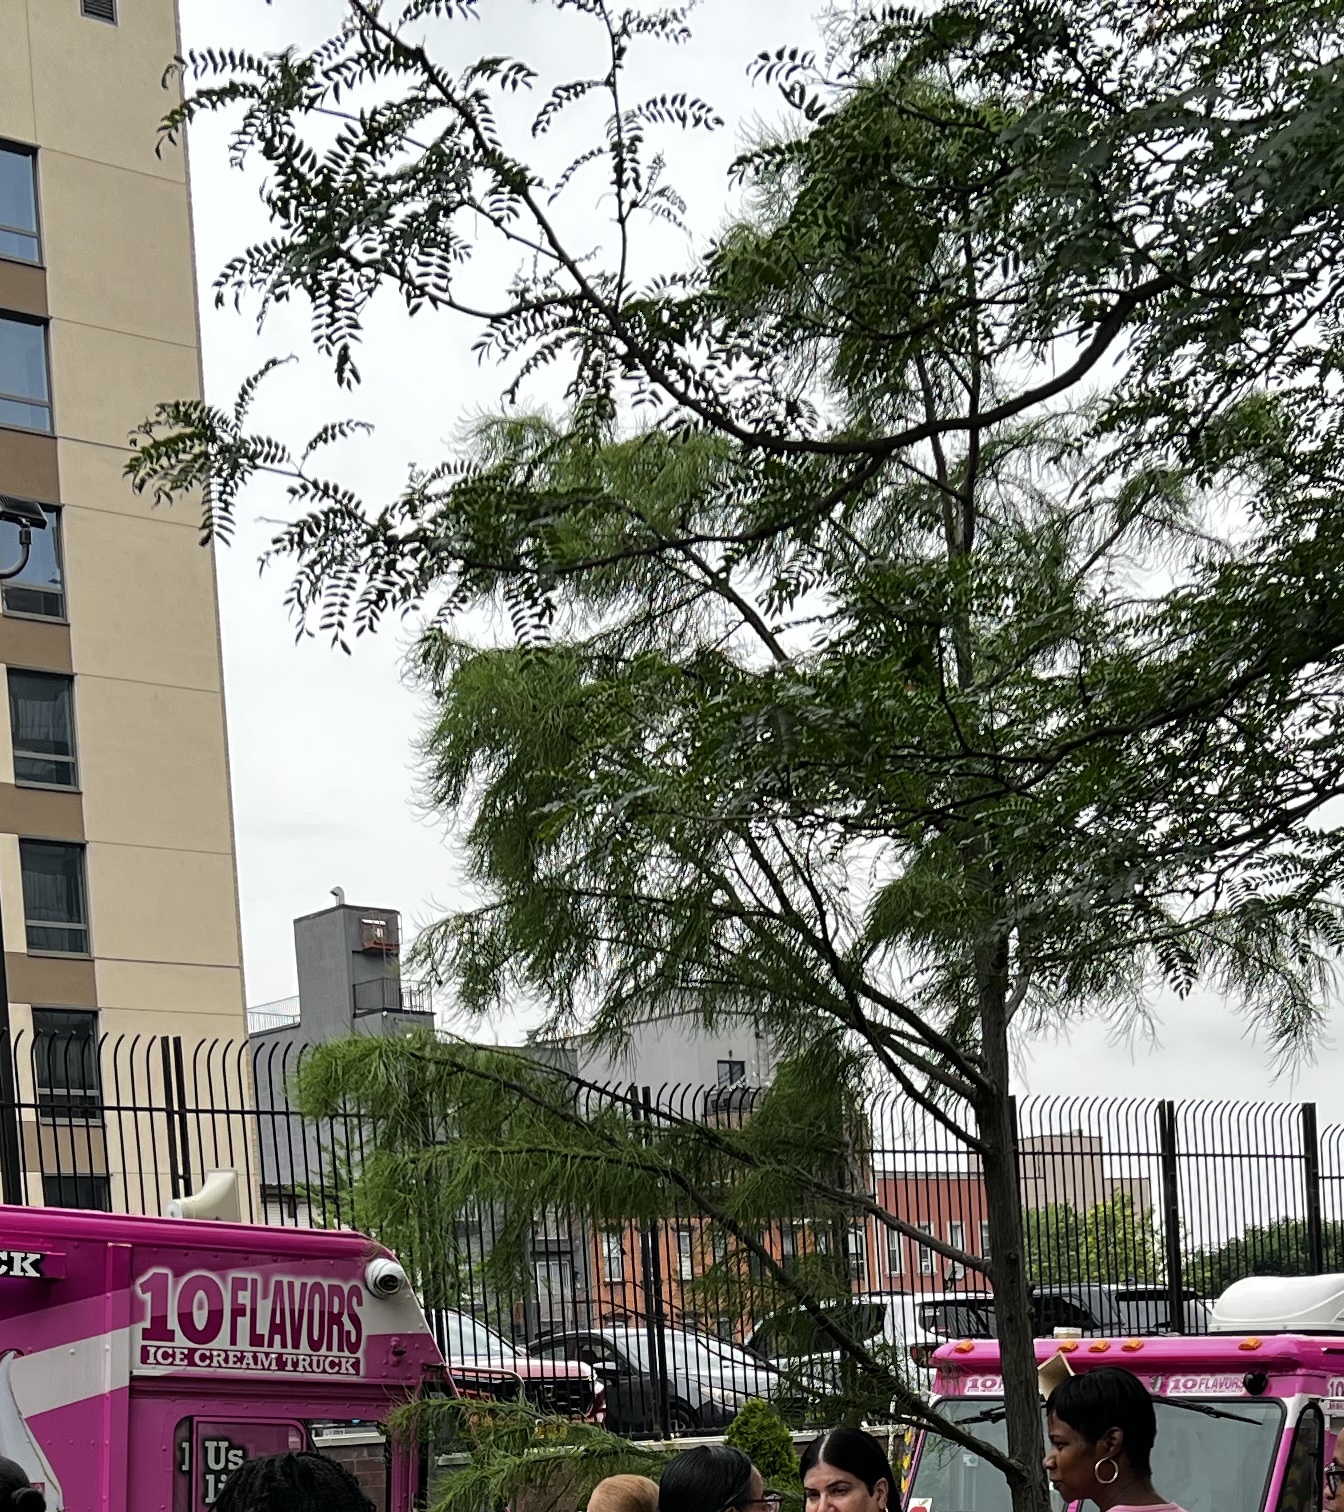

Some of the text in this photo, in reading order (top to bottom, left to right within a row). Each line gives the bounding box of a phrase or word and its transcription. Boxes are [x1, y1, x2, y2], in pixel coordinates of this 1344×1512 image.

[138, 1271, 364, 1355] 10 FLAVORS
[147, 1346, 356, 1375] ICE CREAM TRUCK
[1170, 1378, 1198, 1390] 10
[205, 1440, 244, 1471] Us
